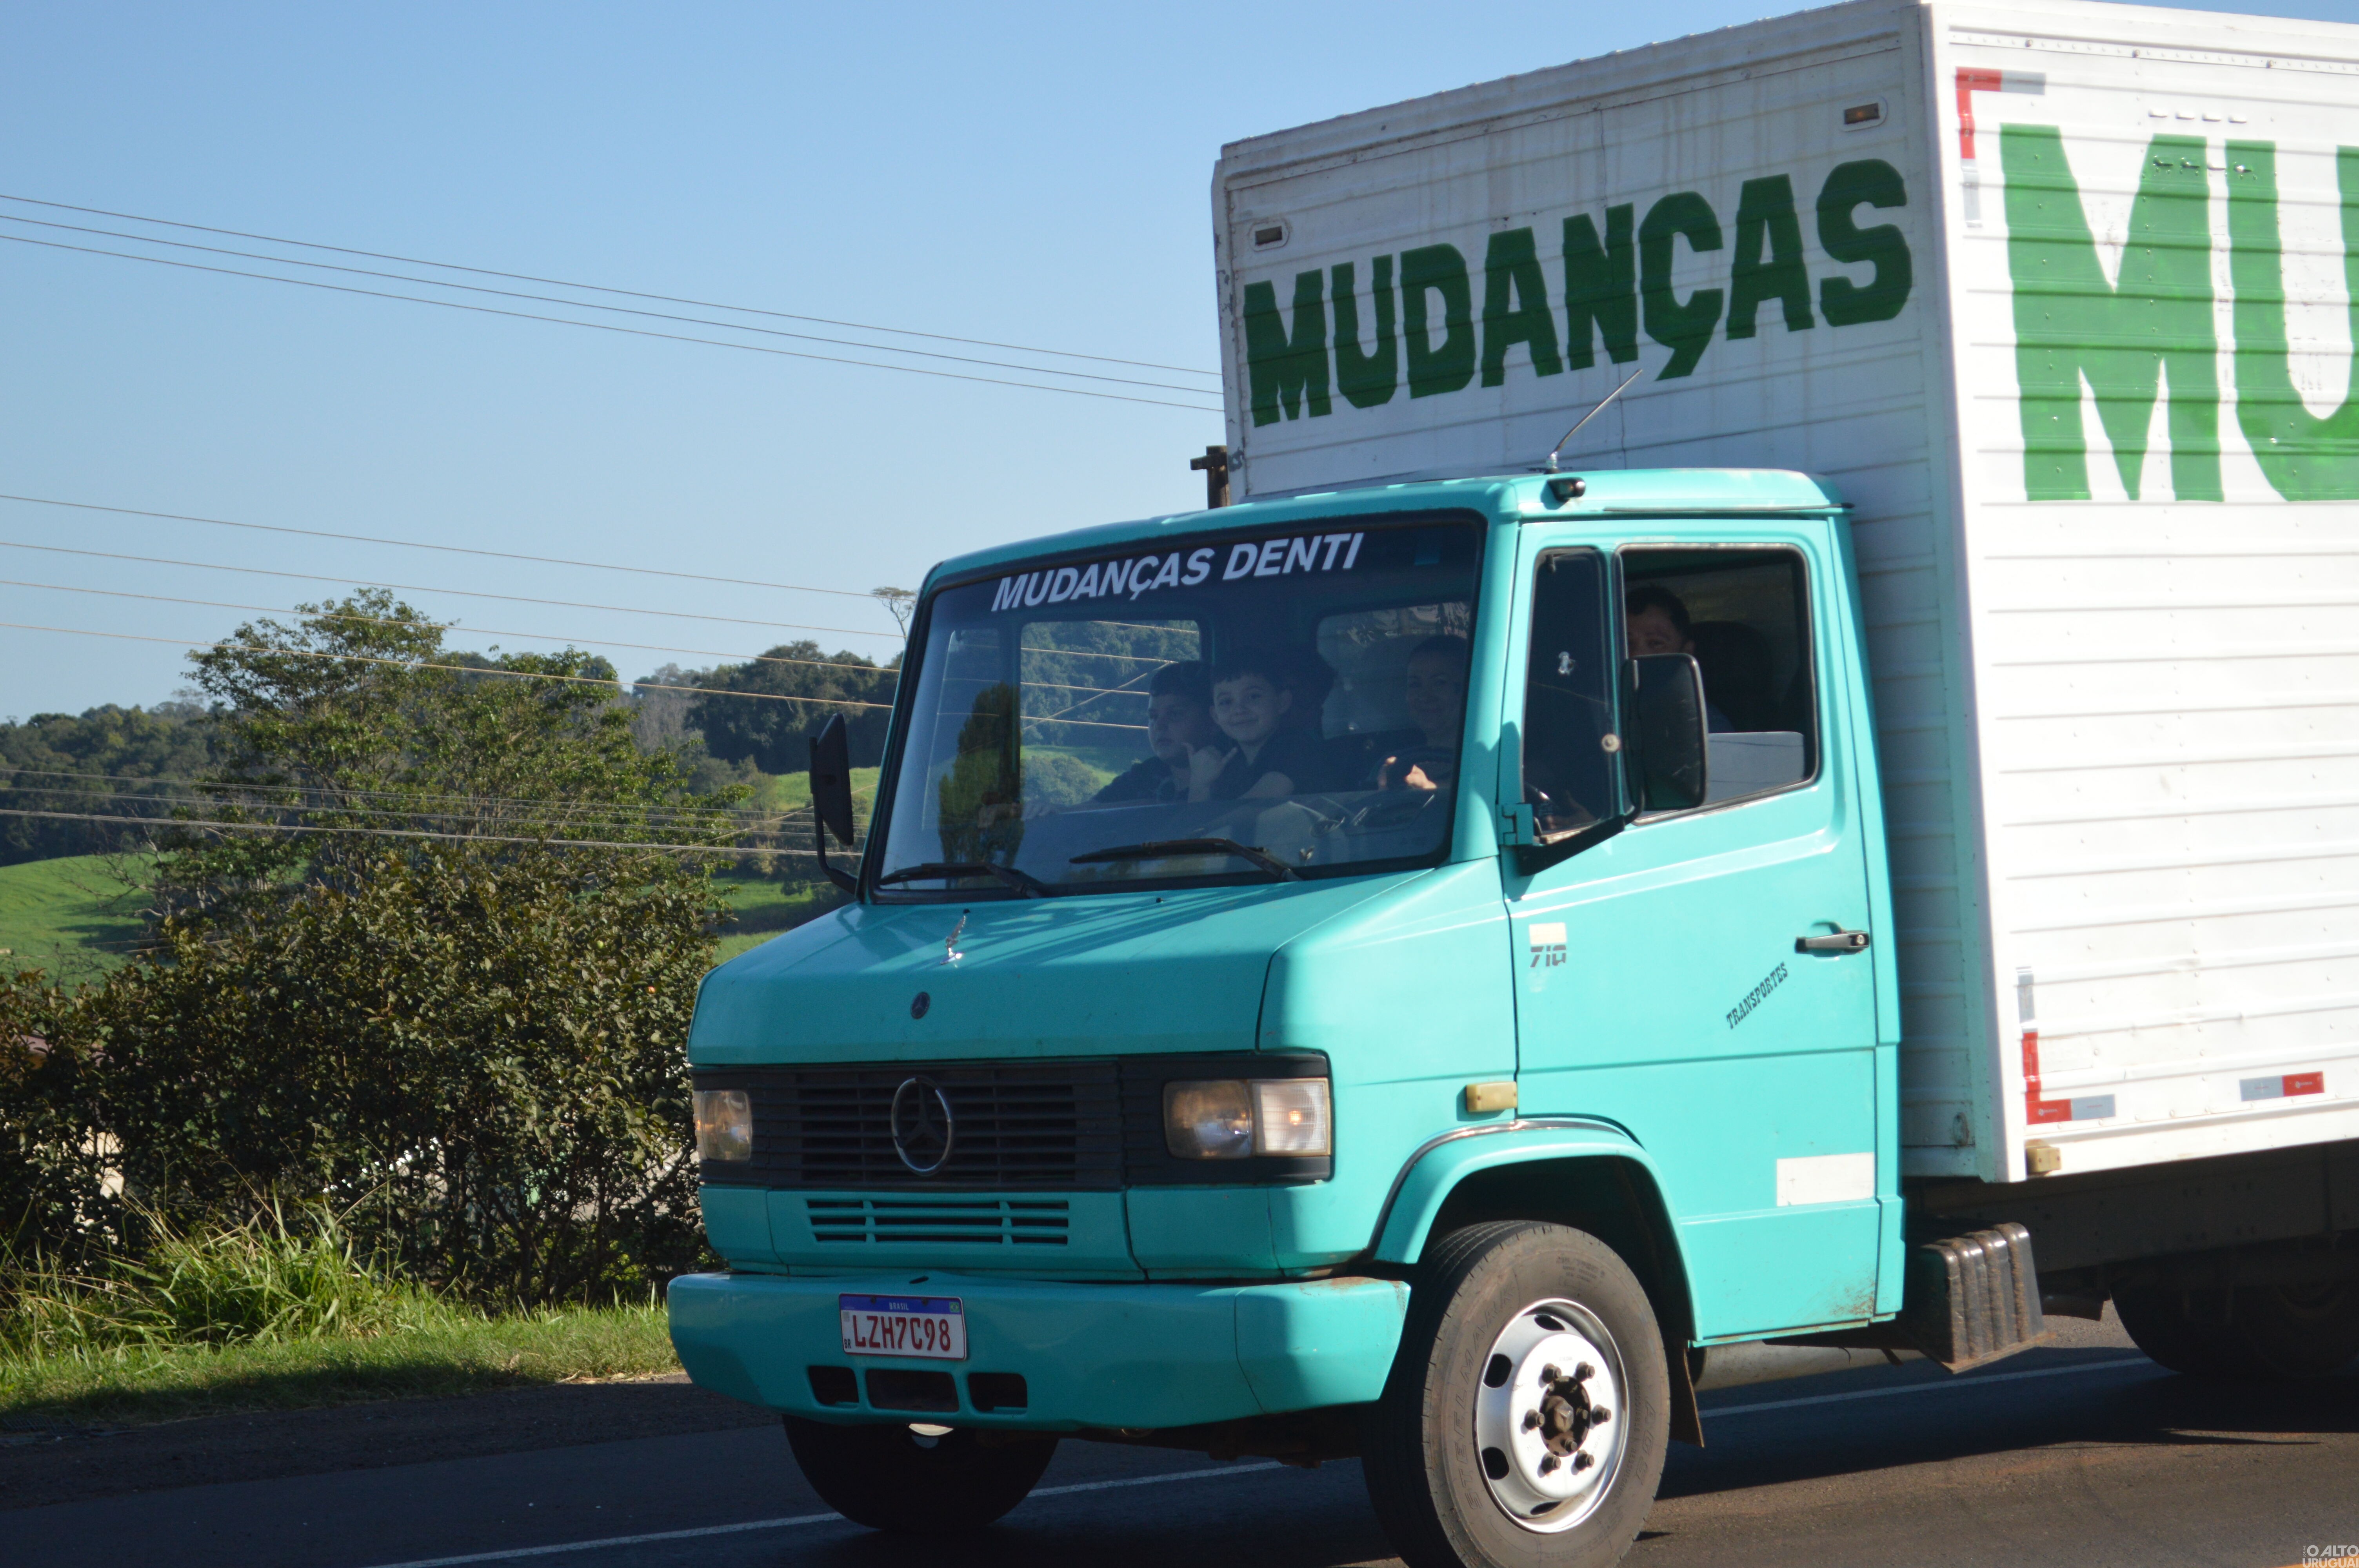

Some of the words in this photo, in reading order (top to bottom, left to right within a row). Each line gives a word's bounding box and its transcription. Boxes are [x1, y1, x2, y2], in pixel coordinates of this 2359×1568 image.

[1243, 159, 1912, 427] MUDANÇAS
[991, 548, 1215, 612] MUDANÇAS
[1223, 532, 1364, 580] DENTI
[1726, 962, 1788, 1029] TRANSPORTES
[889, 1302, 909, 1310] BRASIL
[844, 1339, 852, 1348] BR
[852, 1315, 951, 1351] LZH7C98
